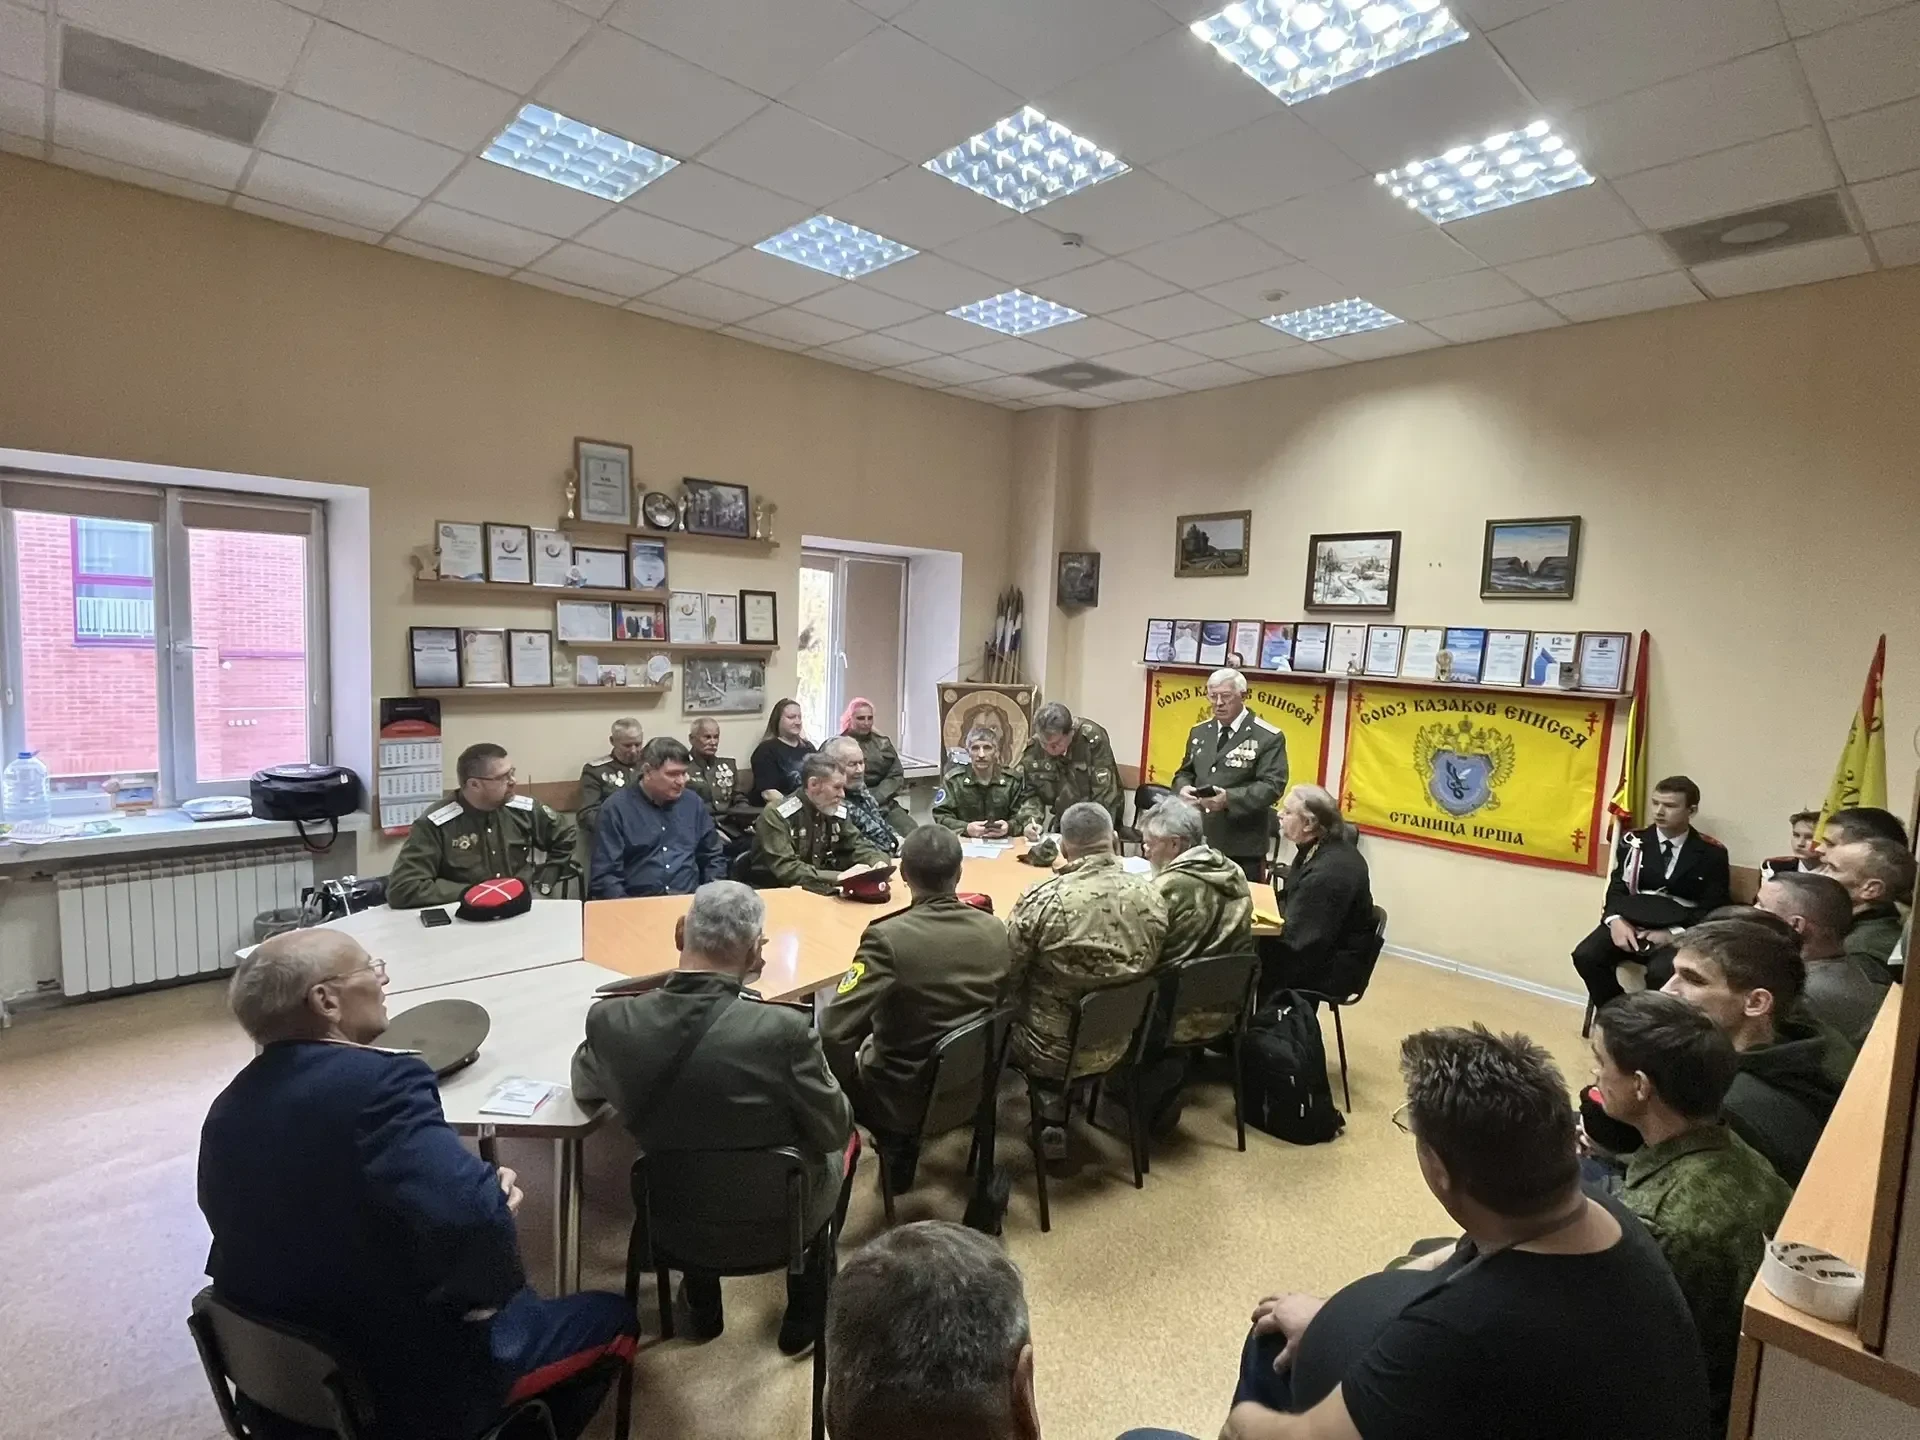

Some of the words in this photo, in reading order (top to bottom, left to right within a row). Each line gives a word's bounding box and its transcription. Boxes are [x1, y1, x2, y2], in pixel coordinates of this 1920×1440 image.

[1157, 688, 1191, 709] СОЮЗ
[1360, 700, 1408, 726] СОЮЗ
[1413, 698, 1497, 716] КАЗАКОВ
[1389, 811, 1466, 836] СТАНИЦА
[1472, 825, 1525, 846] ИРША
